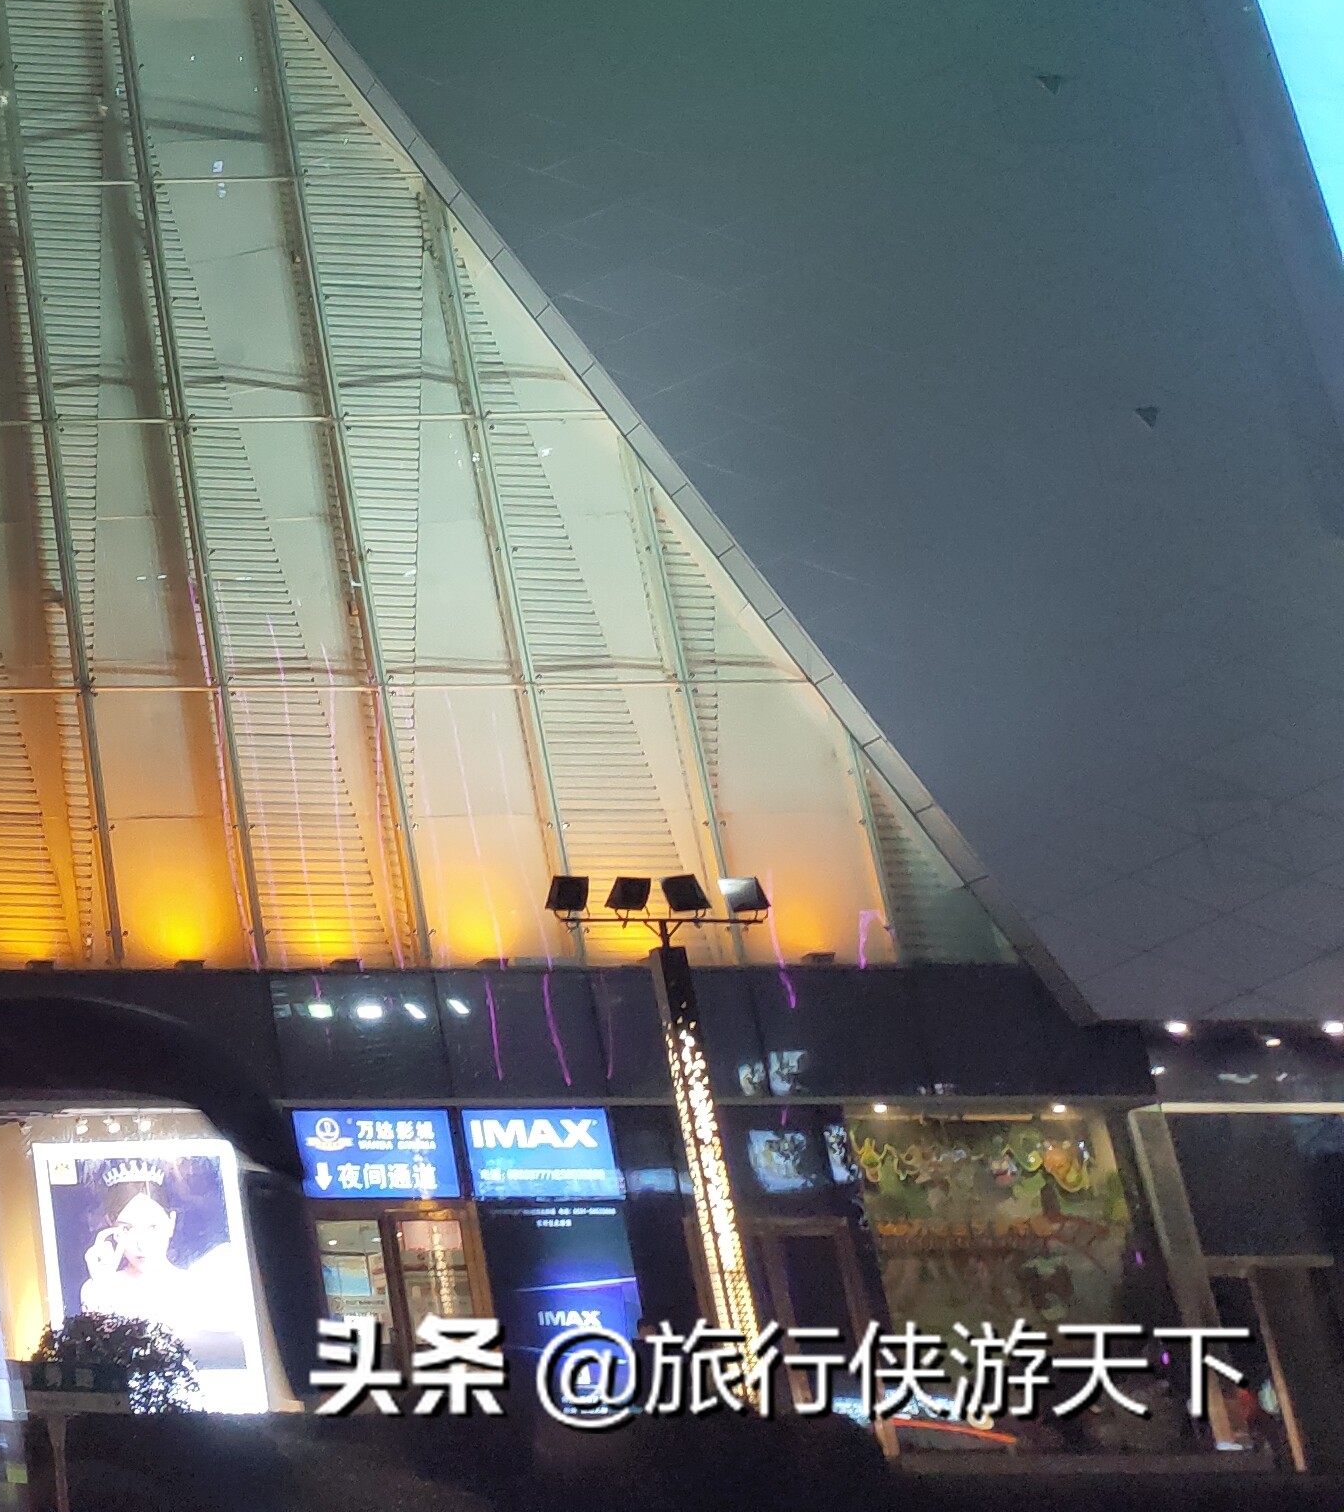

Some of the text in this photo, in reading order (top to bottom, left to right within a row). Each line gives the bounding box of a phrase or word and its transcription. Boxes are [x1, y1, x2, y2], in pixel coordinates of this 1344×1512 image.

[470, 1119, 598, 1148] IMAX
[337, 1162, 437, 1189] 夜间通道
[538, 1310, 602, 1329] IMAX
